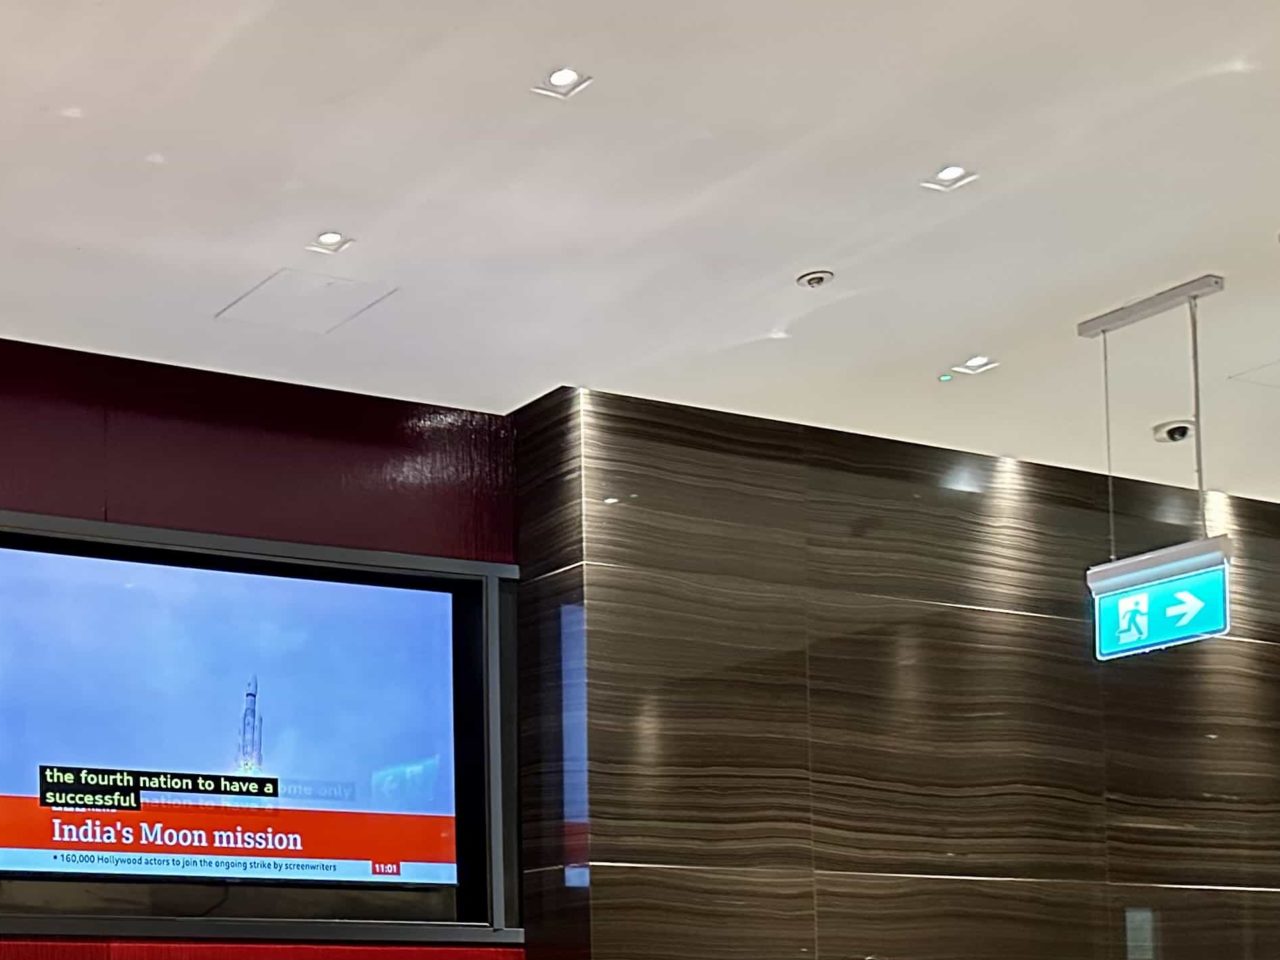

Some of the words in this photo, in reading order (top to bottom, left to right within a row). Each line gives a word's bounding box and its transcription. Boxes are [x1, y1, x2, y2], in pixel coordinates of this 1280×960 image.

[45, 768, 74, 783] the
[80, 770, 134, 786] fourth
[140, 774, 192, 789] nation
[197, 777, 215, 791] to
[220, 777, 258, 793] have
[263, 783, 274, 794] a
[45, 792, 137, 807] successful
[52, 819, 134, 844] India's
[139, 822, 208, 847] Moon
[213, 826, 303, 850] mission
[60, 854, 95, 864] 160,000
[97, 855, 143, 867] Hollywood
[144, 857, 170, 866] actors
[172, 858, 180, 867] to
[181, 858, 198, 868] join
[200, 859, 212, 868] the
[215, 861, 248, 871] ongoing
[249, 861, 271, 869] strike
[273, 861, 283, 872] by
[284, 863, 337, 872] screenwriters
[375, 864, 397, 873] 11:01
